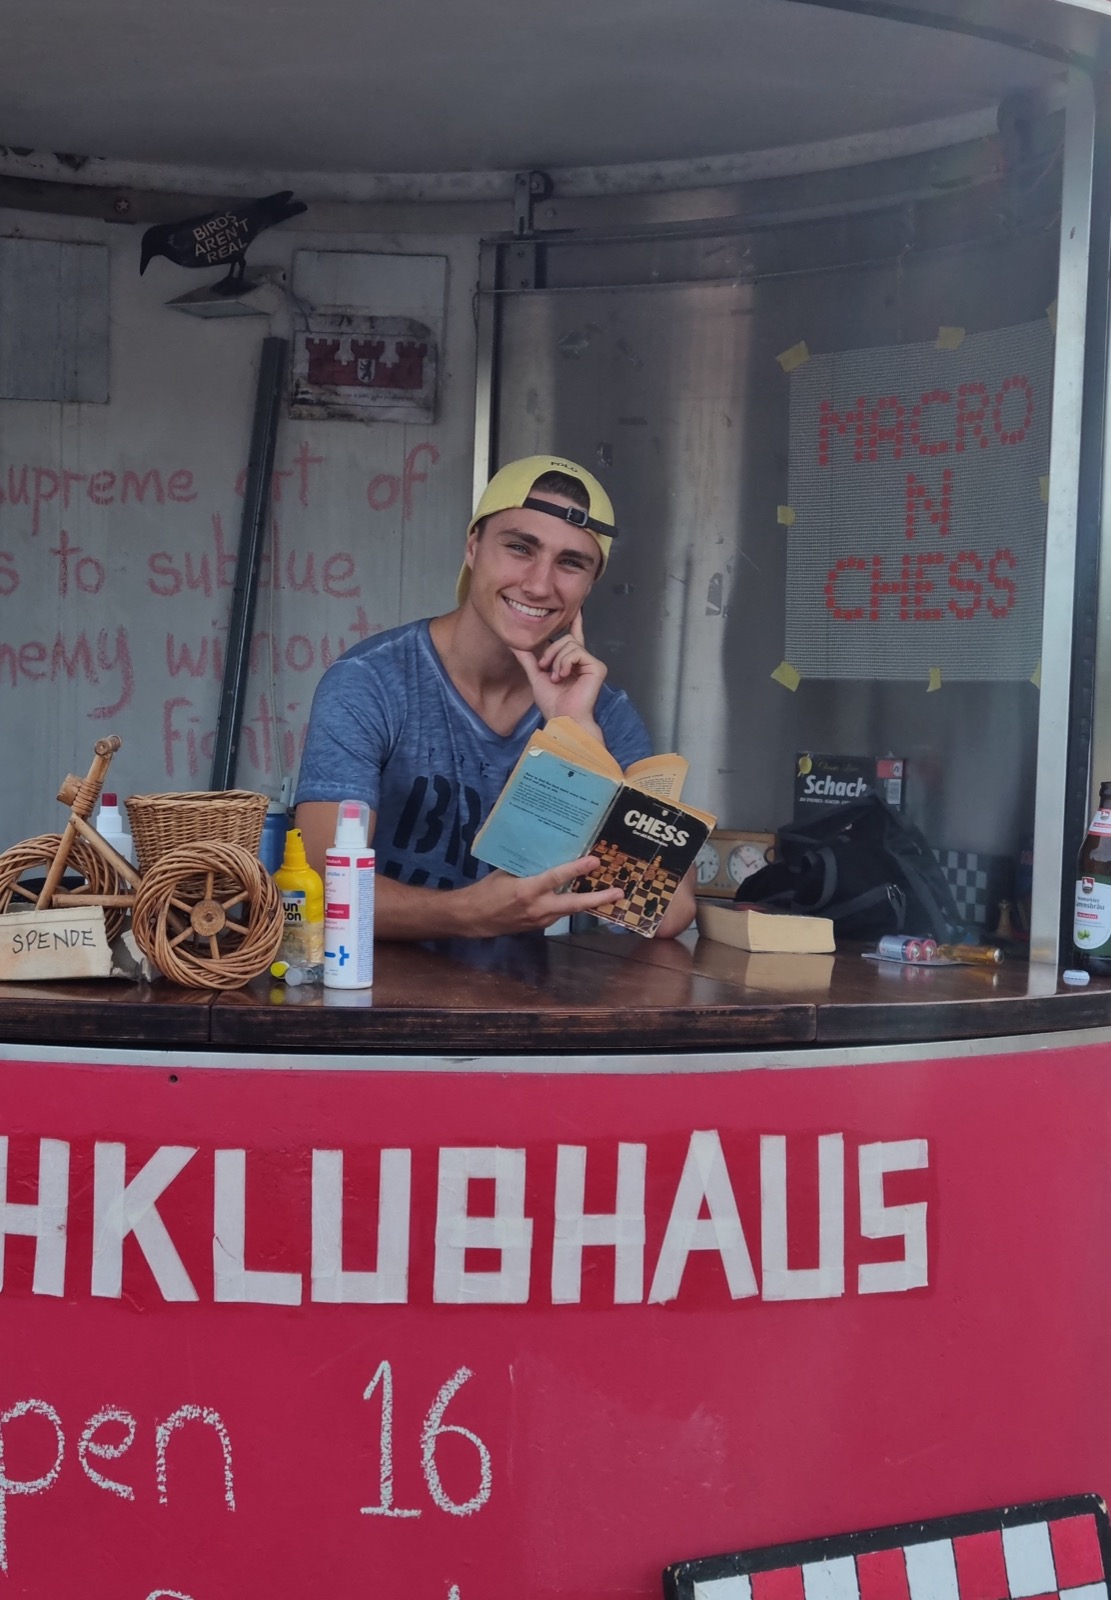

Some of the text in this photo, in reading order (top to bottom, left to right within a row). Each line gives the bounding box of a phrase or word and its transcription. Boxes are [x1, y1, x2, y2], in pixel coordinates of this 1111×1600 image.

[193, 211, 237, 241] BIRDS
[195, 217, 249, 257] AREN'T
[207, 238, 249, 263] REAL
[818, 374, 1035, 467] MACRO
[0, 463, 198, 536] upreme
[366, 442, 440, 521] of
[550, 461, 578, 473] POLO
[905, 468, 952, 540] N
[50, 529, 105, 600] to
[823, 548, 1017, 622] CHESS
[165, 604, 384, 683] wihout
[623, 809, 690, 847] CHESS
[283, 902, 299, 912] un
[12, 929, 96, 954] SPENDE
[360, 1360, 491, 1517] 16
